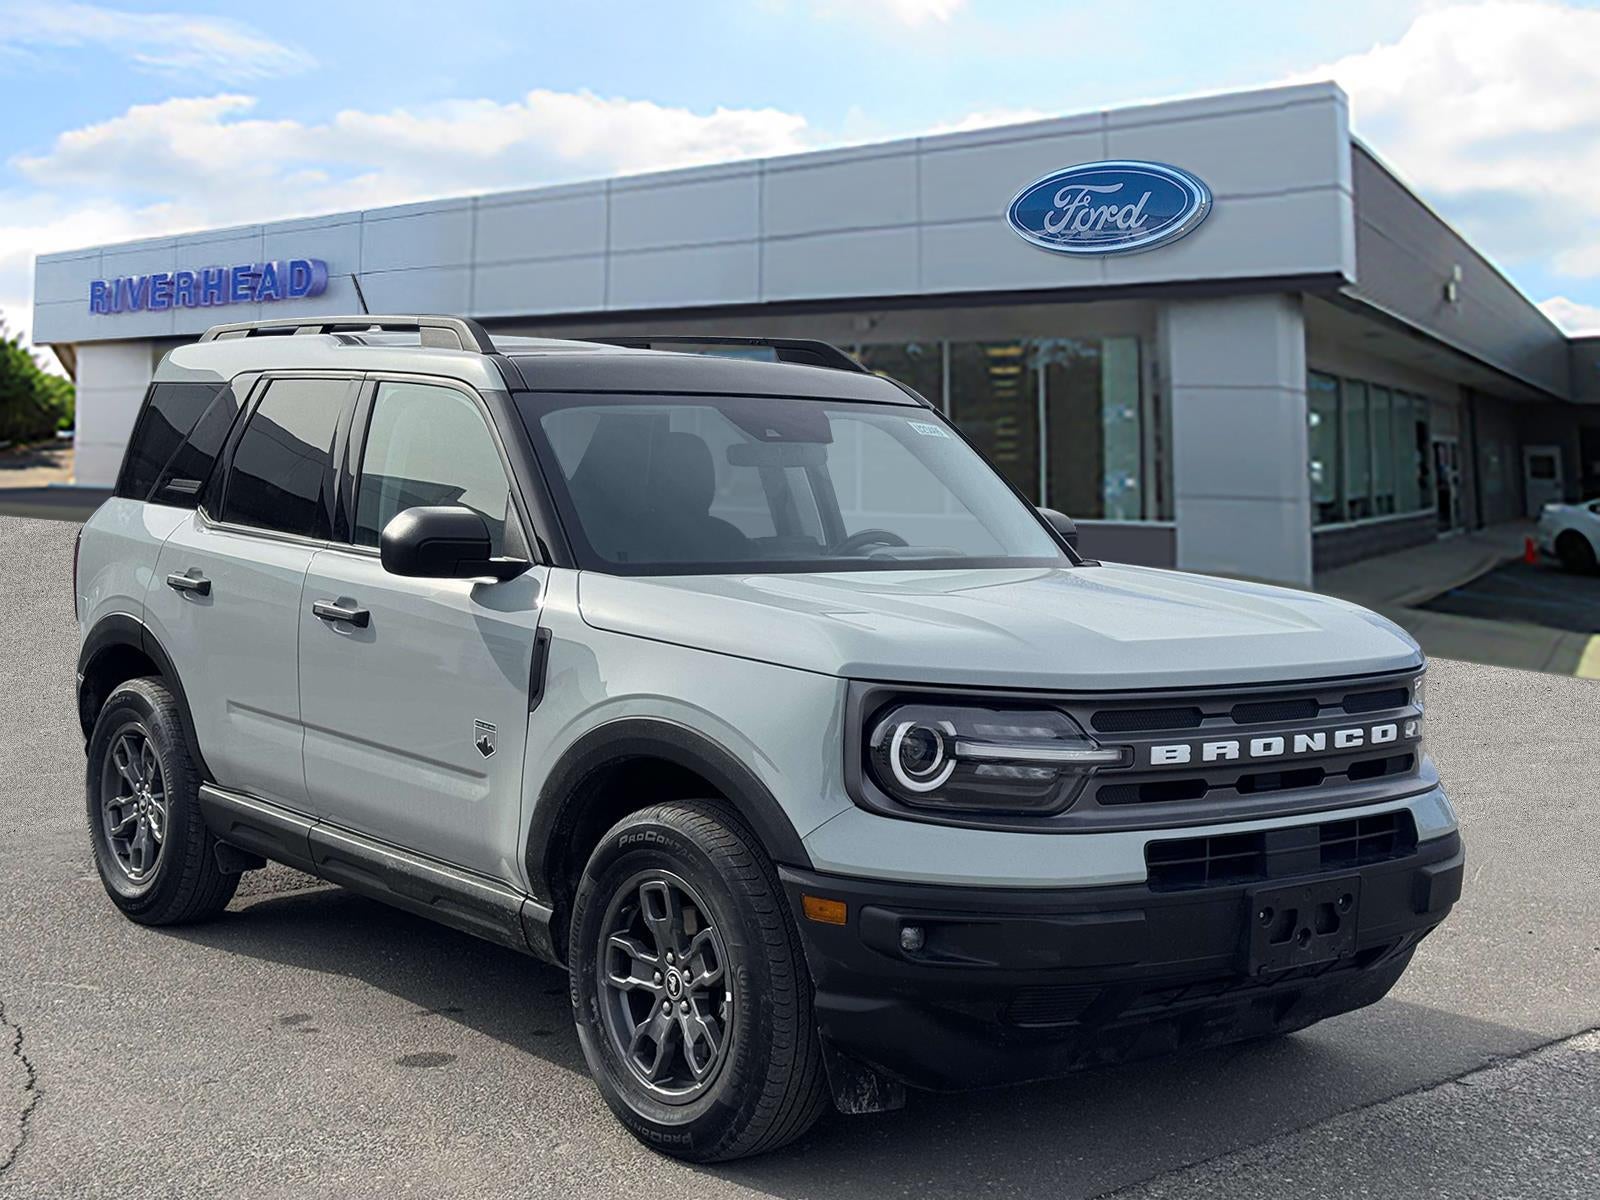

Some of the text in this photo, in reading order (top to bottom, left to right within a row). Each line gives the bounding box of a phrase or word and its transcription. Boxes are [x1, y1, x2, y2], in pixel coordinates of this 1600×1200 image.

[1044, 183, 1152, 234] Ford
[90, 258, 328, 314] RIVERHEAD
[1150, 723, 1397, 766] BRONCO
